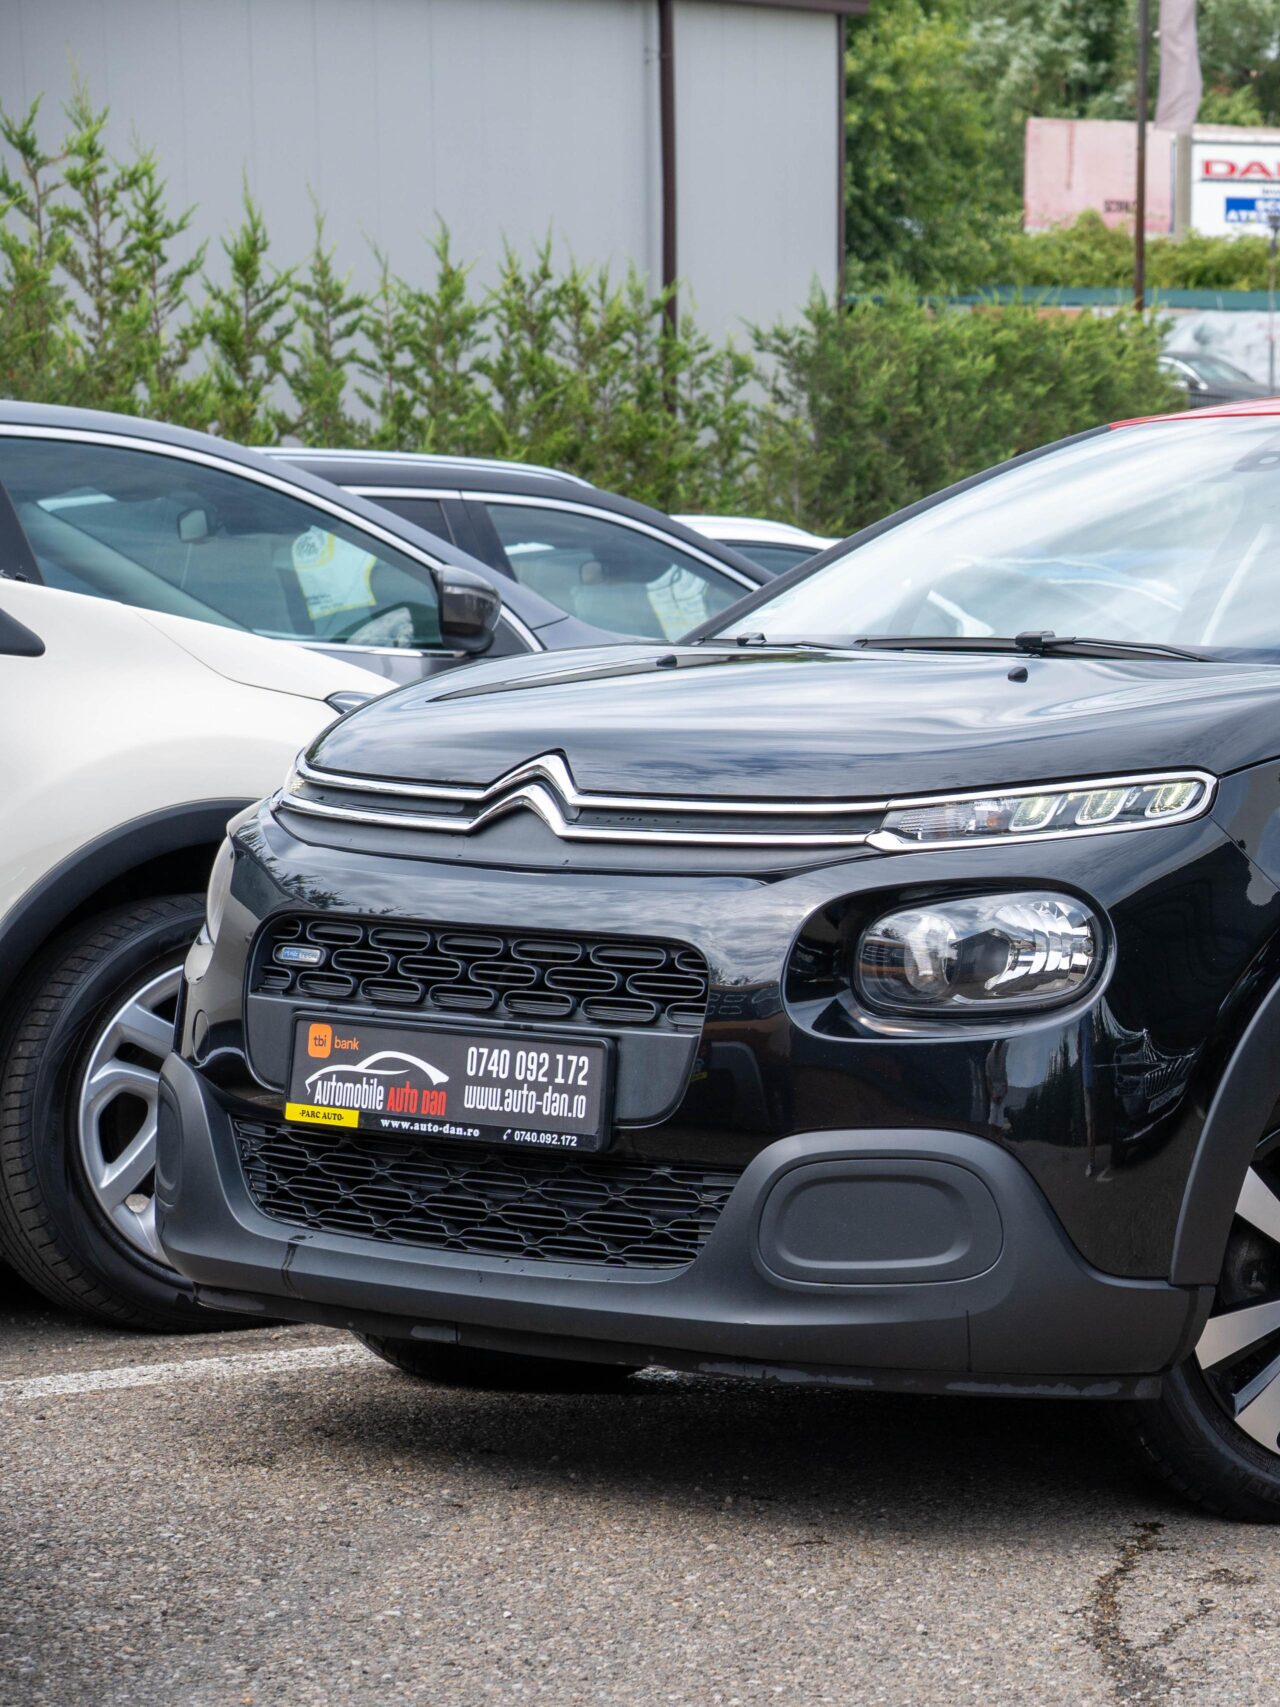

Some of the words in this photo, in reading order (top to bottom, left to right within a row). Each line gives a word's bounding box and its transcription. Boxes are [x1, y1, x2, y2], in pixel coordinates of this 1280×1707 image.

[313, 1035, 327, 1047] tbi
[334, 1036, 360, 1050] bank
[466, 1046, 510, 1079] 0740
[515, 1050, 550, 1082] 092
[554, 1054, 589, 1086] 172
[314, 1074, 384, 1110] Automobile
[464, 1083, 587, 1119] www.auto-dan.ro
[381, 1119, 480, 1137] www.auto-dan.ro
[514, 1130, 577, 1147] 0740.092.172
